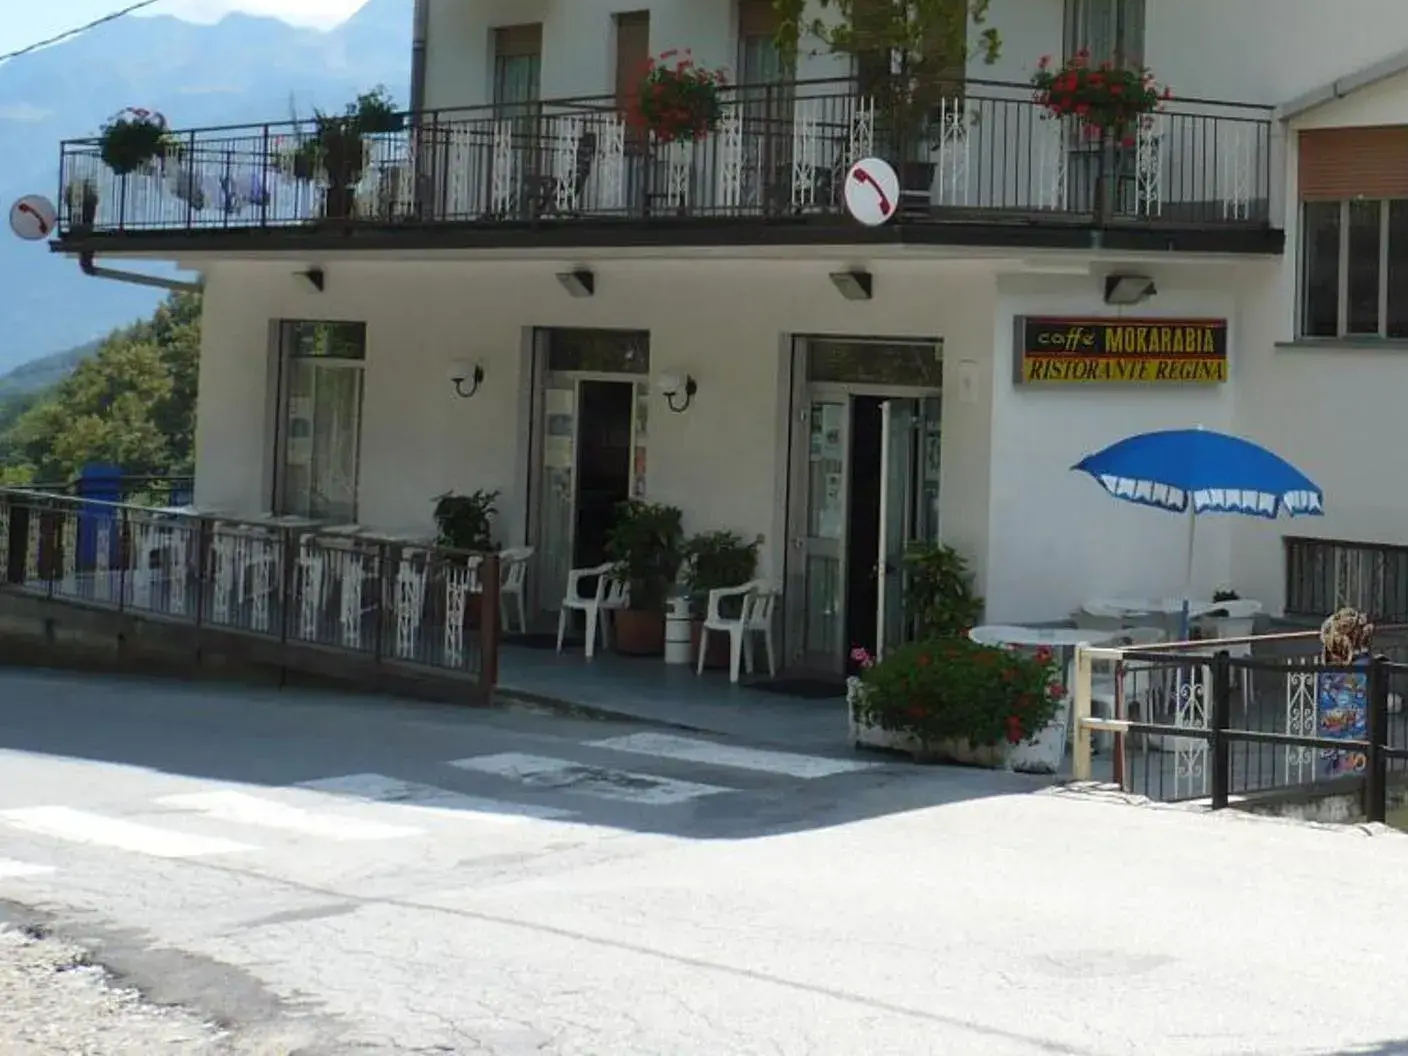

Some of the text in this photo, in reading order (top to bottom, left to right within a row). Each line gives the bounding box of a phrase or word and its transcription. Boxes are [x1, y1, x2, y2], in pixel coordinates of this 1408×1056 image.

[1105, 327, 1214, 353] MOKARABIA
[1029, 358, 1223, 380] RISTORANTE REGINA
